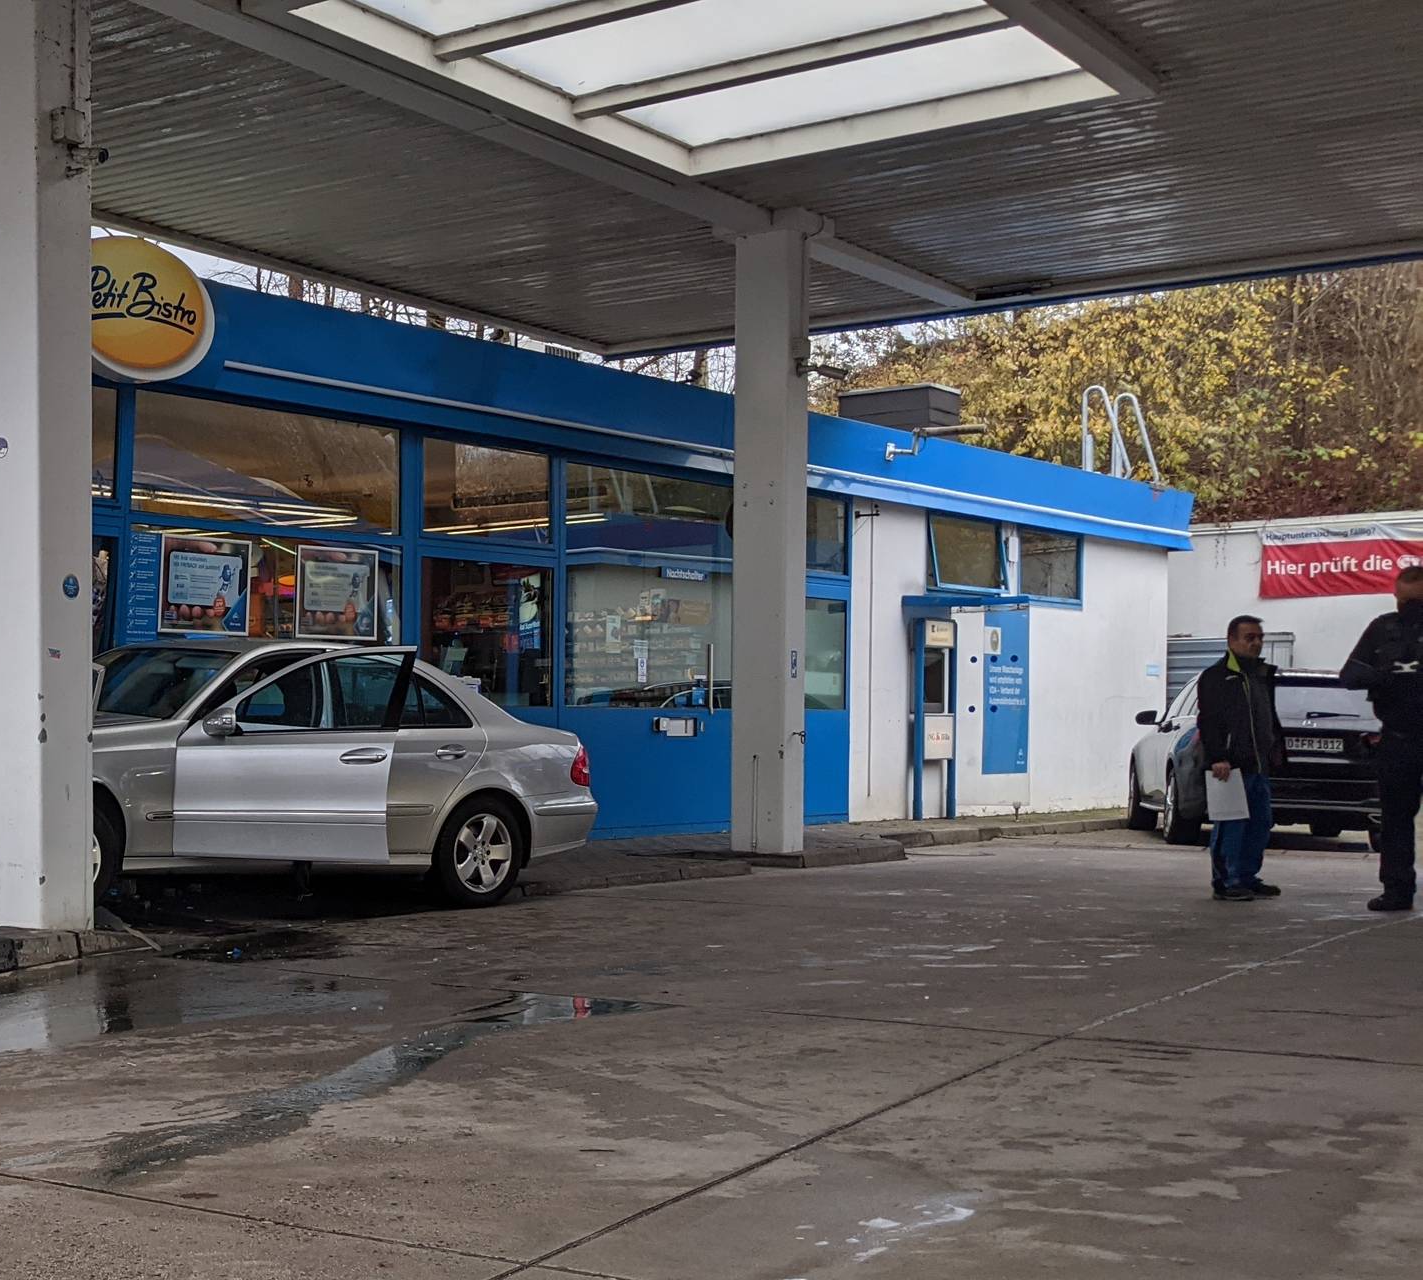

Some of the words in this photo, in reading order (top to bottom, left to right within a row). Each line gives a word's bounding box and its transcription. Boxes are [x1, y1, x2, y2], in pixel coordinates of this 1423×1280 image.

[91, 265, 127, 309] Petit
[126, 272, 196, 326] Bistro
[1266, 528, 1348, 541] Hauptuntersuchung
[1349, 526, 1376, 537] fällig?
[666, 568, 704, 581] Nachtschalter
[1267, 559, 1306, 575] Hier
[1309, 555, 1358, 578] prüft
[1362, 554, 1393, 571] die
